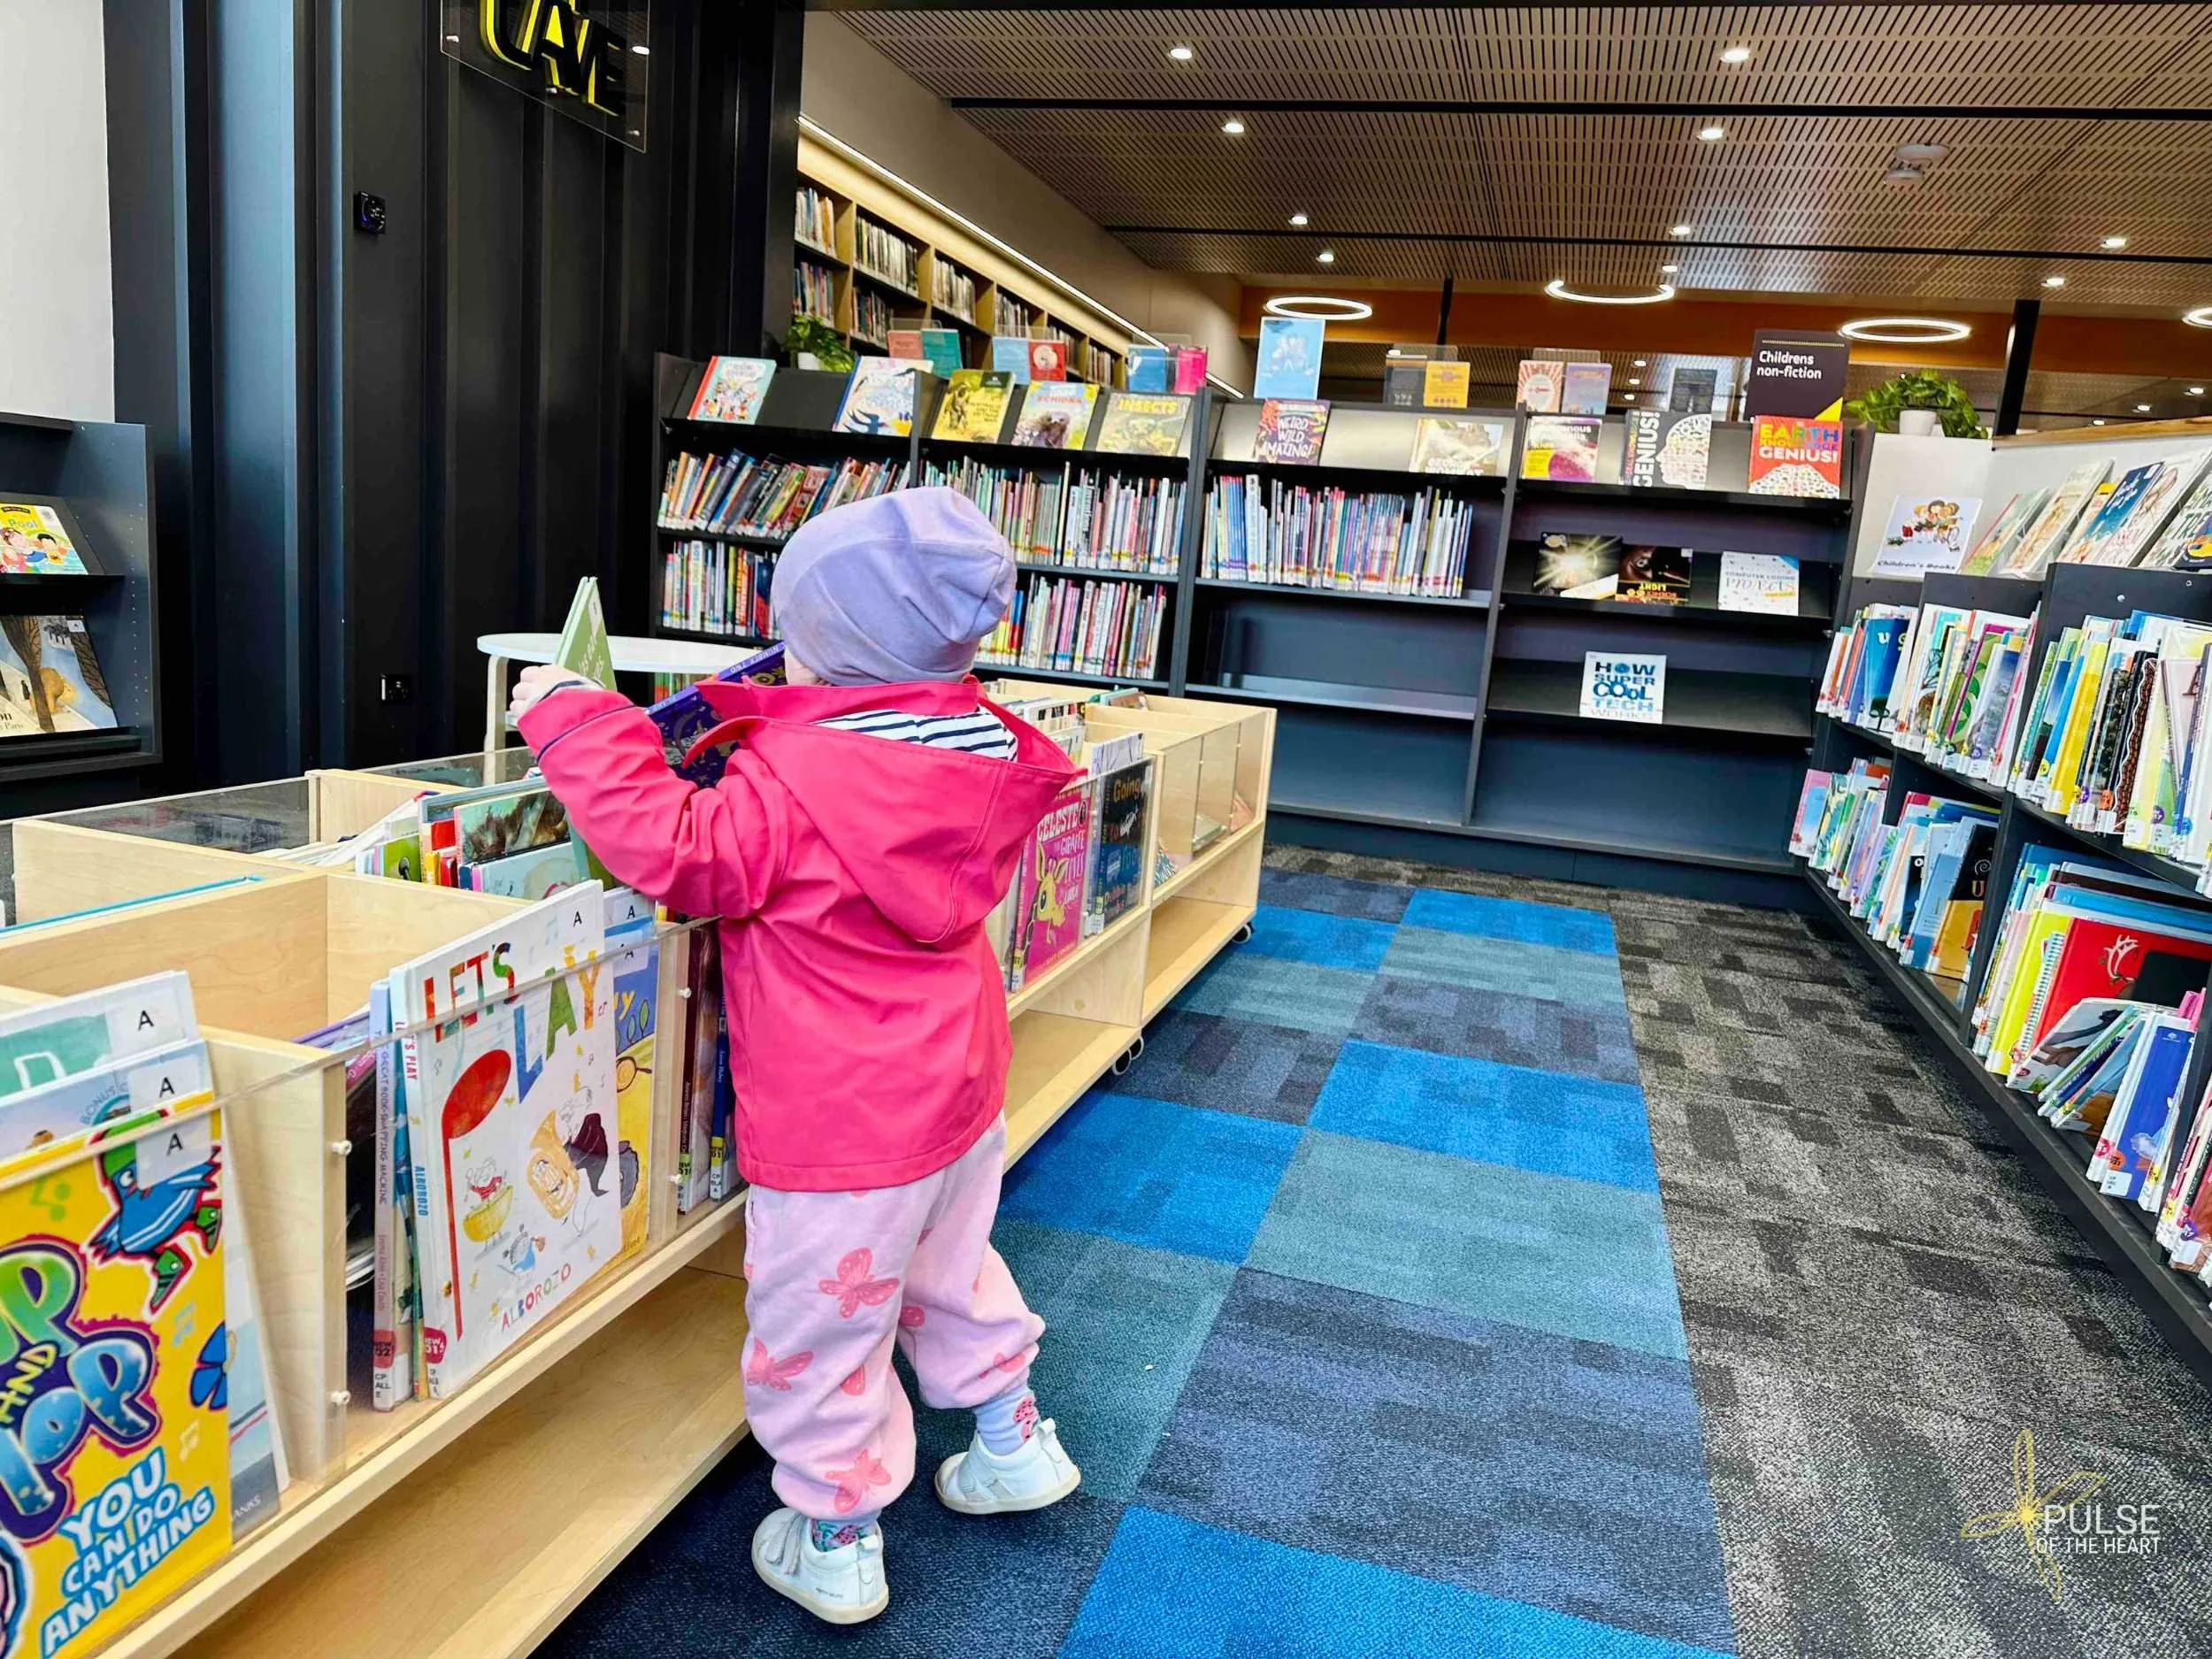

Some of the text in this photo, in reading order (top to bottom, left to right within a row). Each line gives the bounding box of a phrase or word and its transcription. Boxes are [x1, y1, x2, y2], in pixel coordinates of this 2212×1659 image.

[1759, 350, 1814, 365] Childrens
[1756, 365, 1822, 379] non-fiction
[1278, 428, 1305, 442] WILD
[1760, 424, 1839, 442] EARTH
[1632, 411, 1661, 488] GENIUS!
[1759, 447, 1838, 463] GENIUS!
[1595, 662, 1655, 675] HOW
[1594, 674, 1655, 685] SUPER
[1594, 697, 1654, 711] TECH
[572, 911, 582, 927] A
[626, 905, 635, 919] A
[138, 1010, 154, 1031] A
[404, 1056, 419, 1080] PLAY
[159, 1077, 175, 1098] A
[165, 1133, 183, 1156] A
[500, 1263, 572, 1333] ALBOROZO
[62, 1451, 165, 1551] YOU
[65, 1488, 178, 1591] CAN DO
[43, 1491, 213, 1657] ANYTHING
